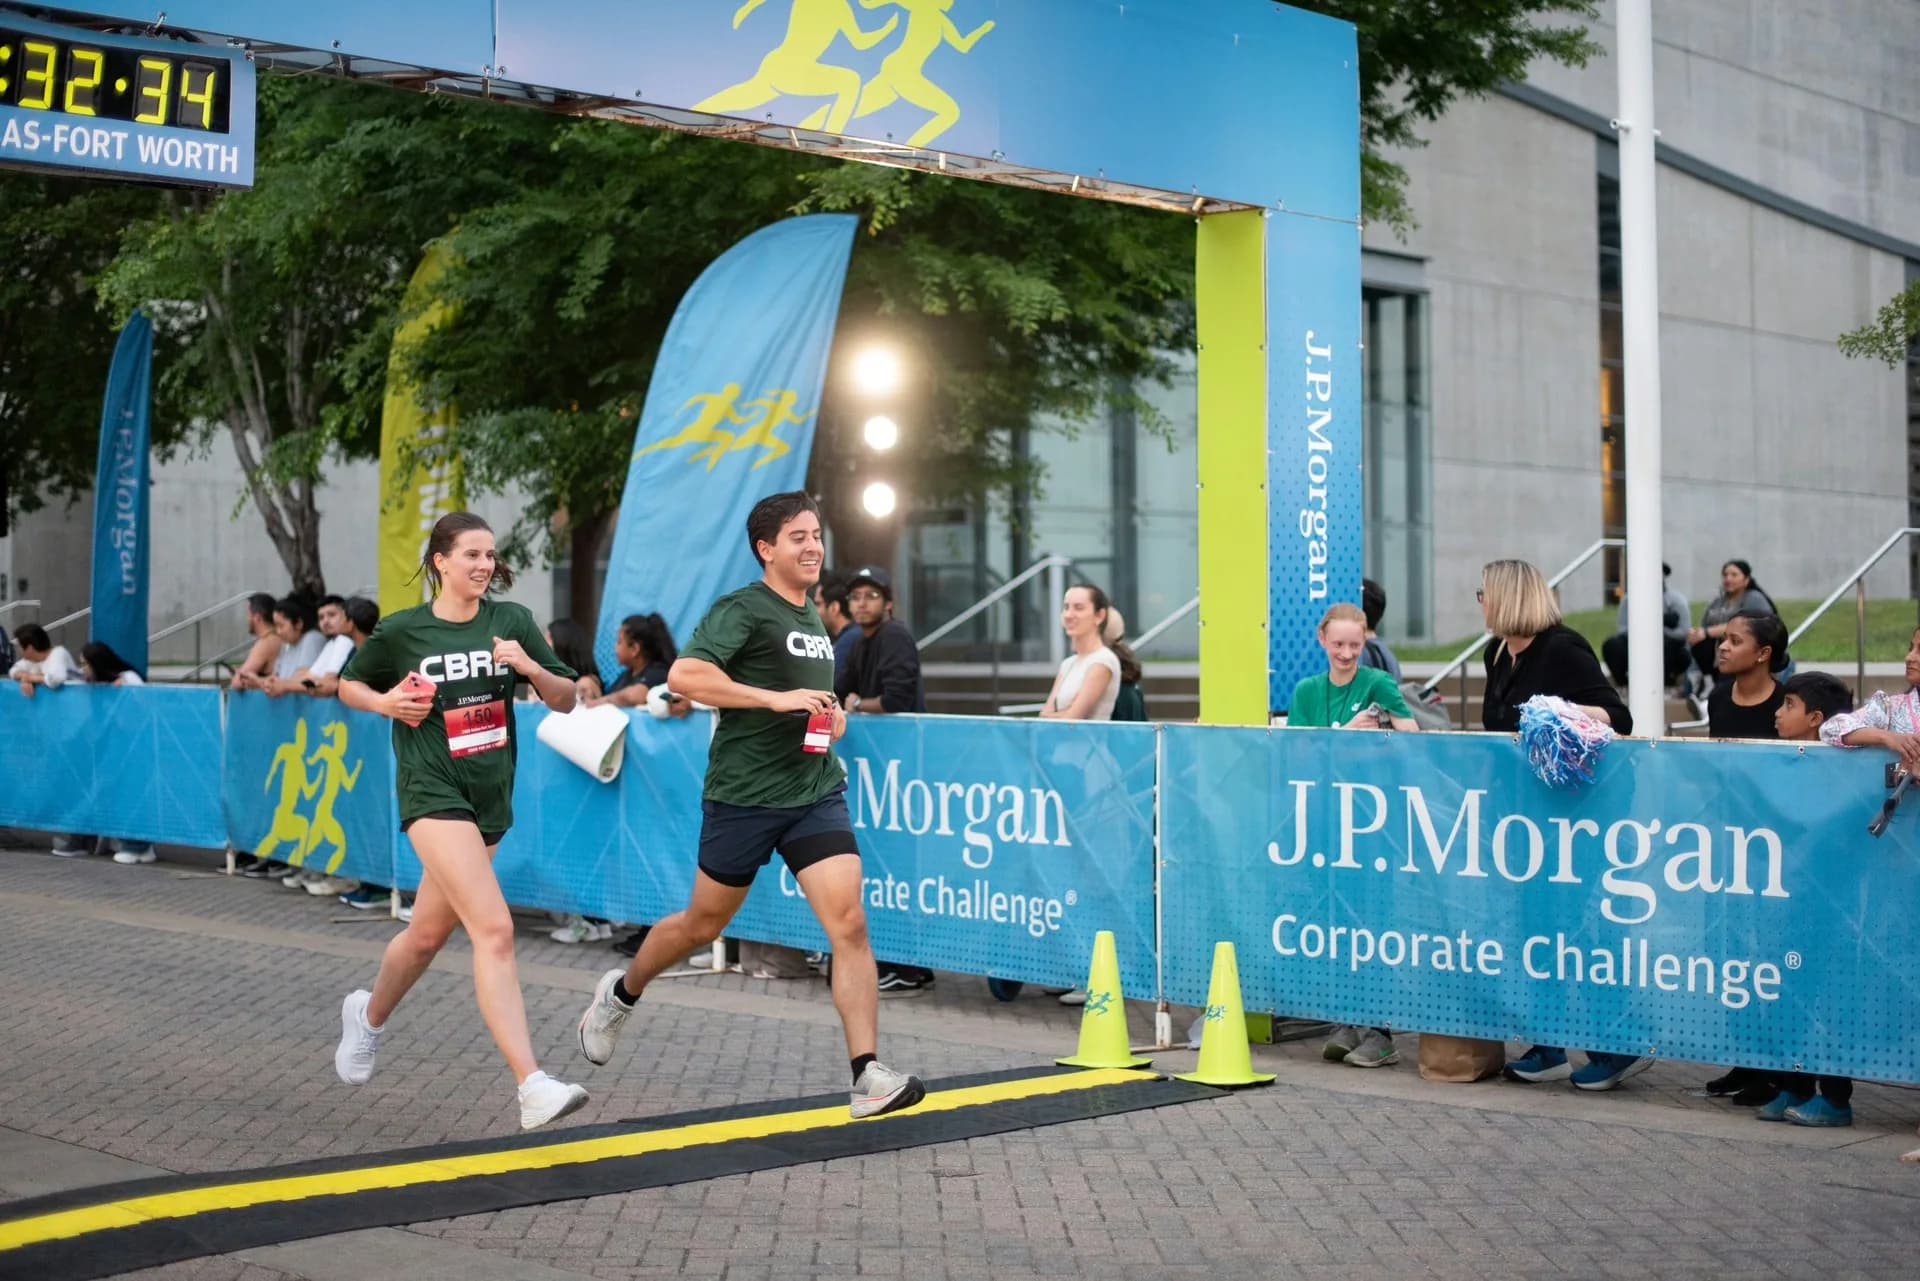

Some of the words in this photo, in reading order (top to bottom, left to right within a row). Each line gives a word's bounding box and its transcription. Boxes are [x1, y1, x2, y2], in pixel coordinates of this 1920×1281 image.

[0, 118, 129, 160] AS-FORT
[138, 134, 240, 174] WORTH
[1300, 330, 1333, 602] J.P.Morgan
[838, 756, 1072, 869] Morgan
[1267, 780, 1790, 924] J.P.Morgan
[780, 863, 911, 911] Crate
[1271, 914, 1503, 975] Corporate
